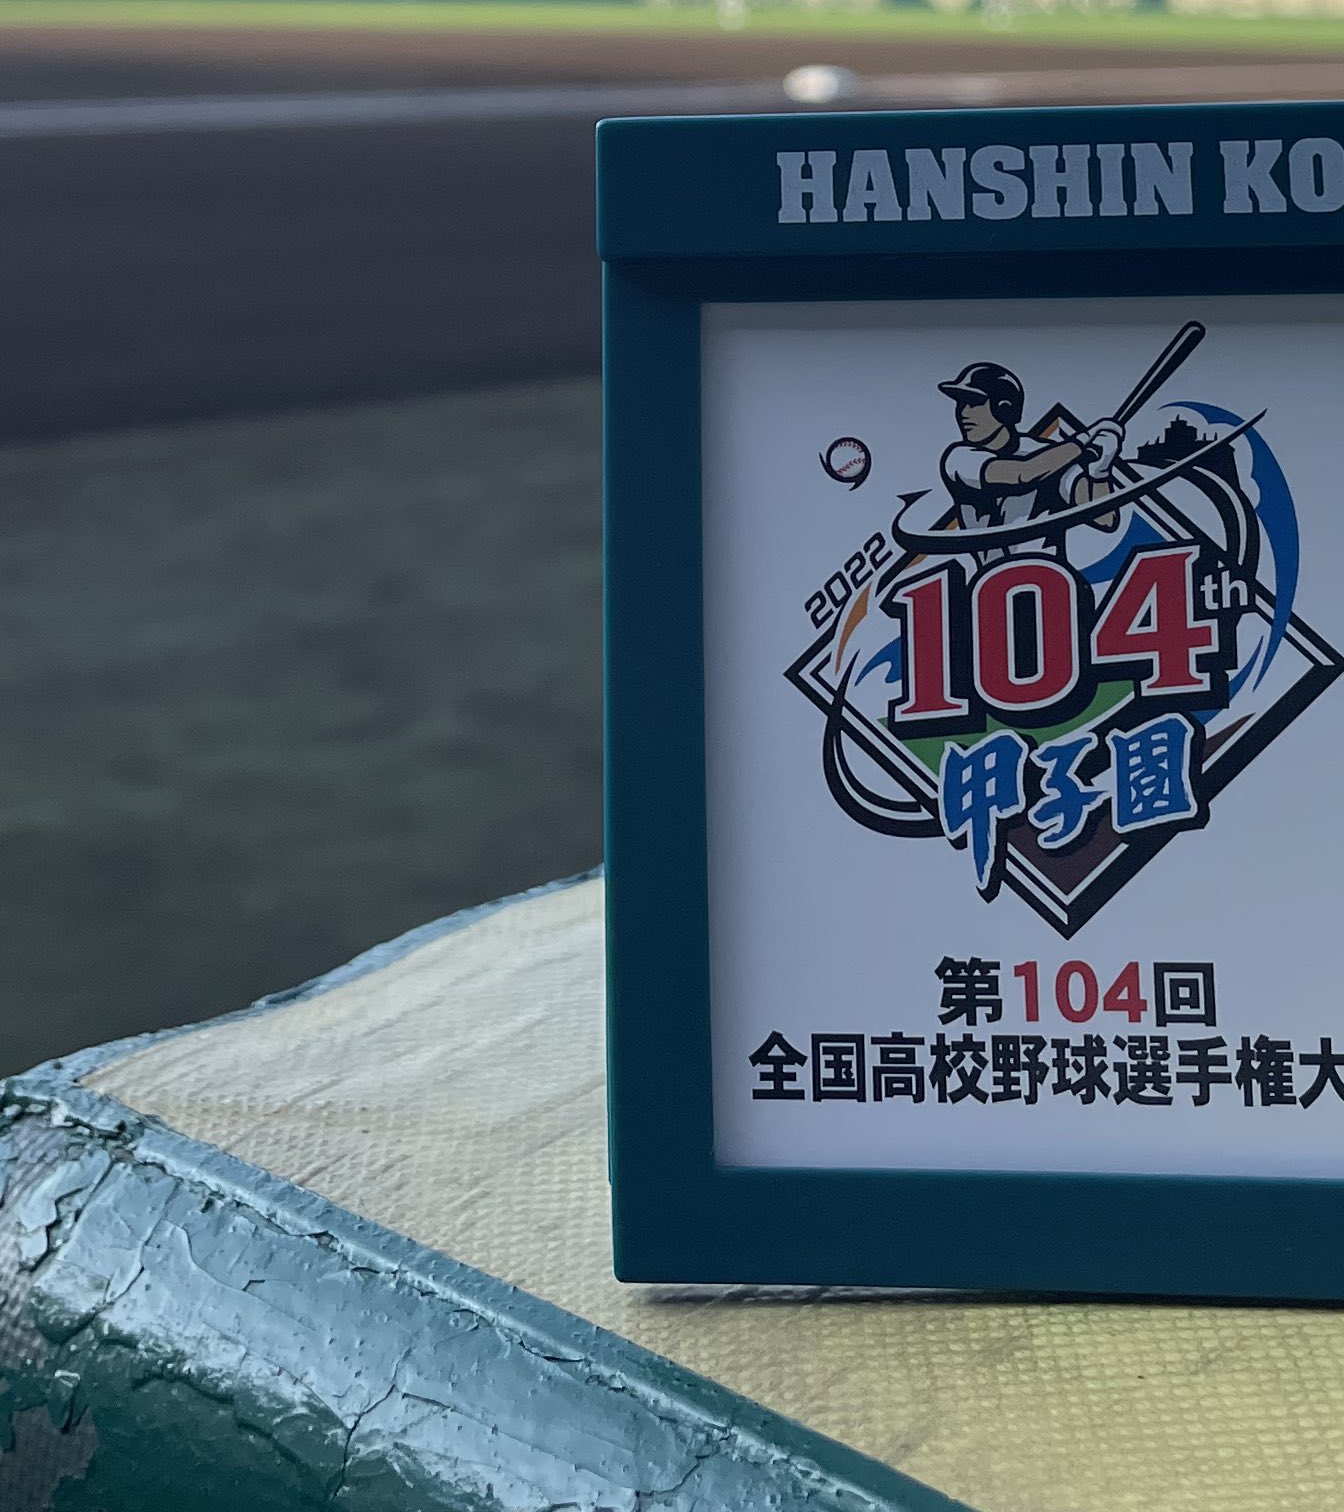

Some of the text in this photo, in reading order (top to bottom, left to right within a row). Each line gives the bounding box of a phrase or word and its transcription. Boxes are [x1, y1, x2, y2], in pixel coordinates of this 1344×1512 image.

[776, 141, 1194, 224] HANSHIN
[803, 530, 896, 630] 2022
[942, 712, 1196, 890] 甲子園
[934, 956, 1217, 1028] 第104回
